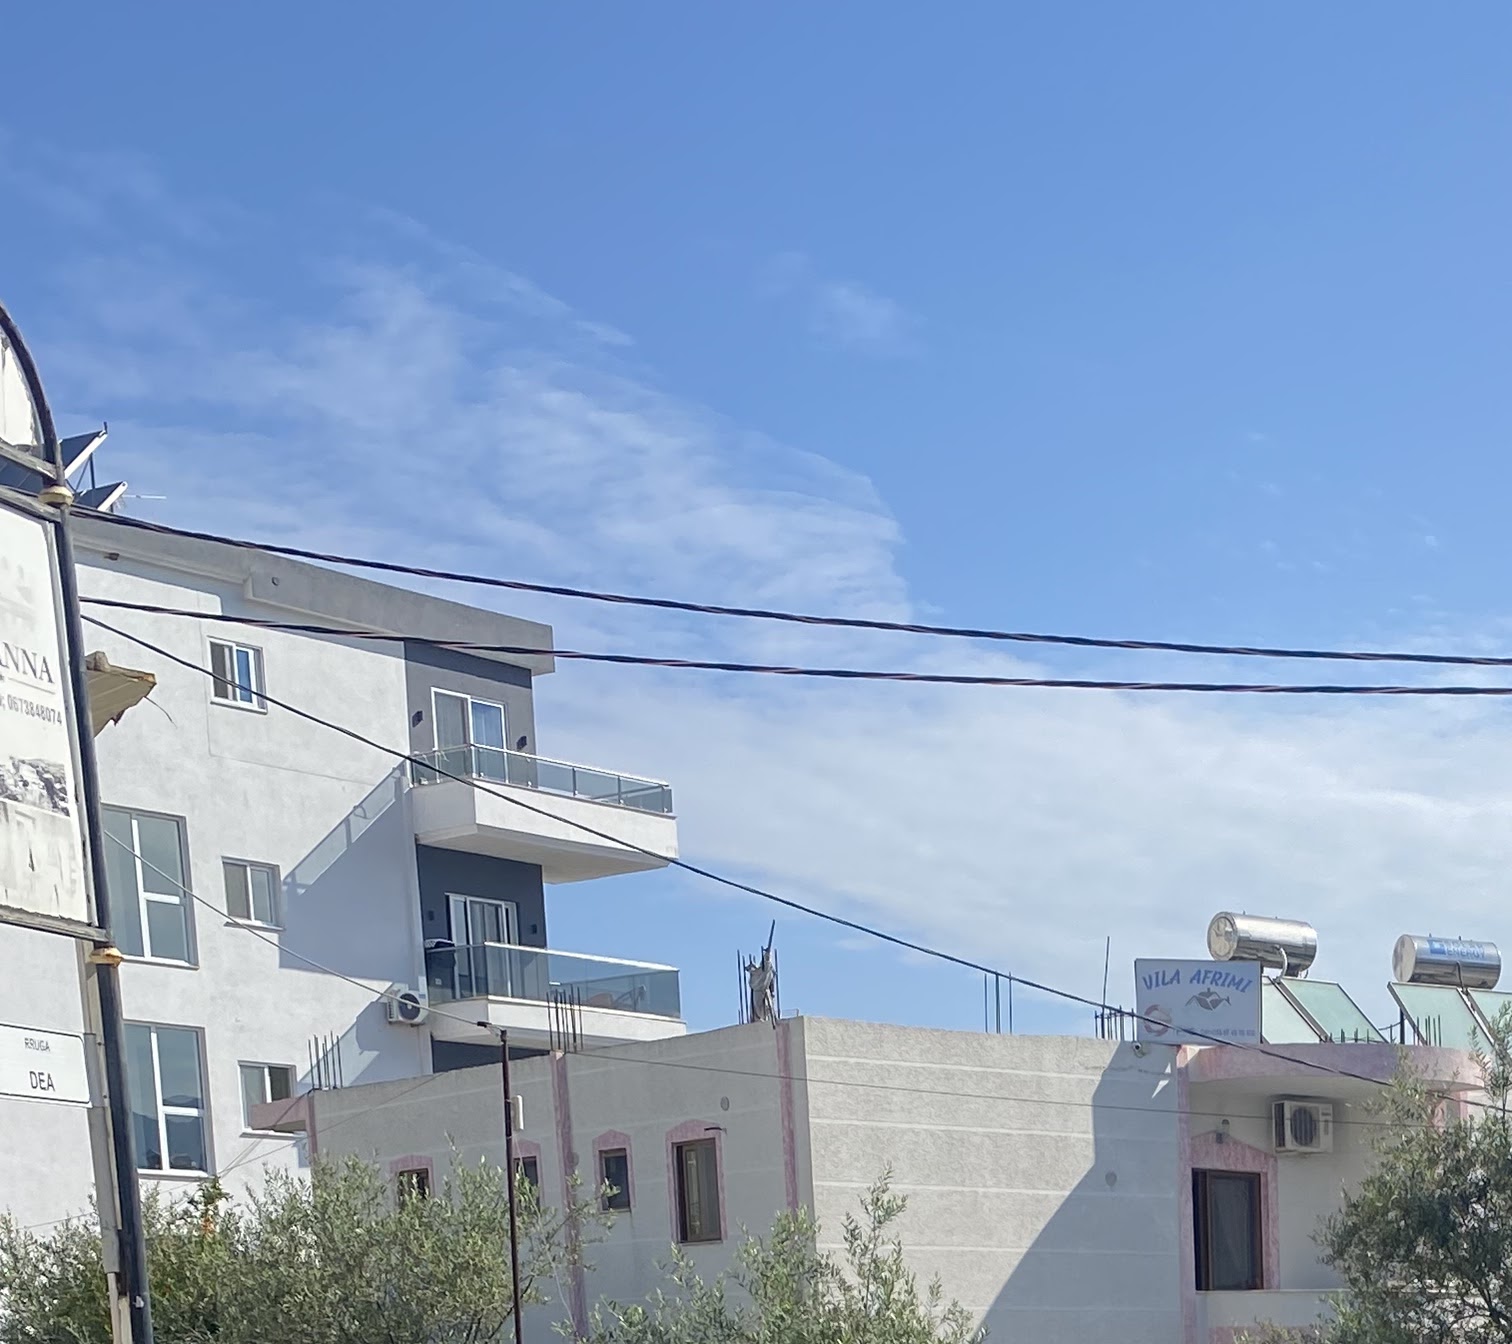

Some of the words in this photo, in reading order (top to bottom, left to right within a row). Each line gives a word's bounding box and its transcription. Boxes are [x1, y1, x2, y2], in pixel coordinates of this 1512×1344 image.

[0, 642, 55, 684] NNA
[1142, 968, 1181, 991] VILA
[1189, 968, 1254, 993] AFRIMI
[29, 1070, 56, 1092] DEA
